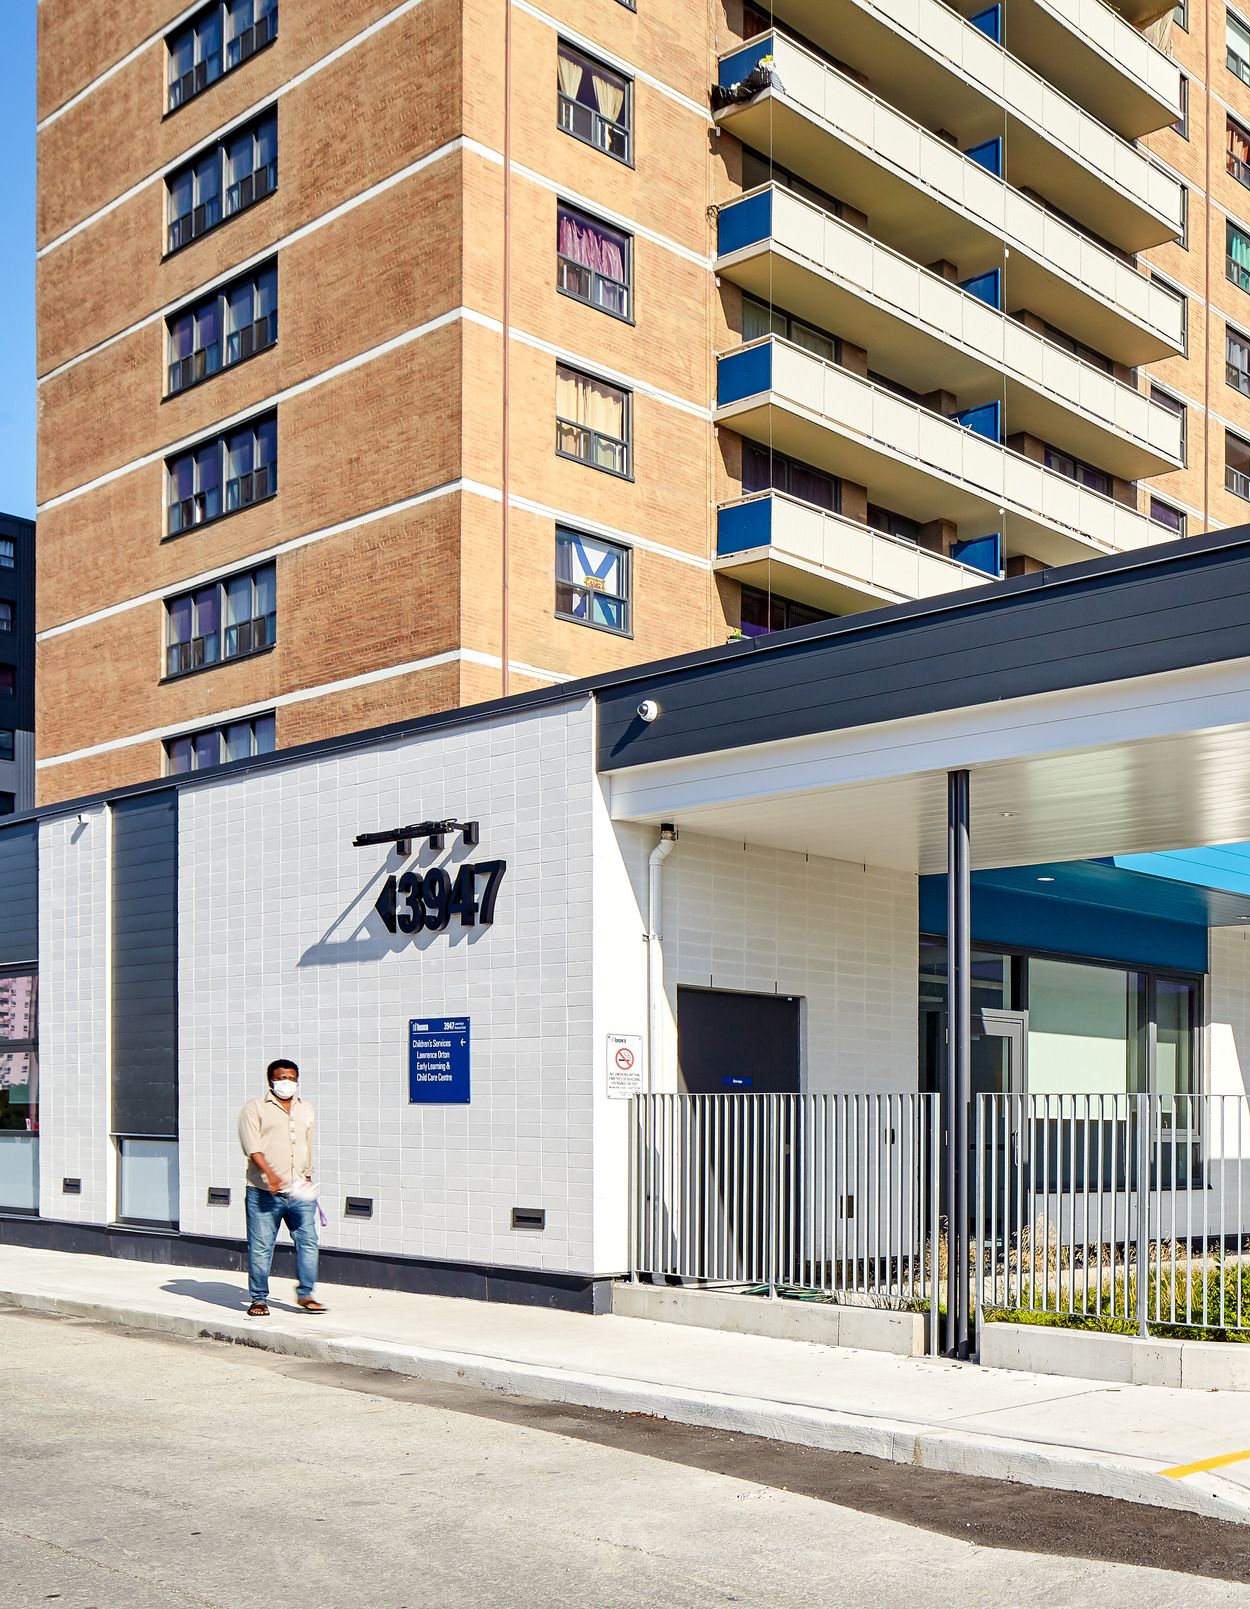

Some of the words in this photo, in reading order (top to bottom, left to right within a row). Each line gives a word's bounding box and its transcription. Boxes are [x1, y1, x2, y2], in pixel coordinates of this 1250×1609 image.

[397, 859, 506, 934] 3947
[444, 1022, 454, 1030] 3947
[412, 1040, 432, 1048] Children's
[433, 1039, 451, 1048] Services
[417, 1050, 437, 1059] Lawrence
[438, 1050, 450, 1059] Orton
[417, 1061, 427, 1071] Early
[428, 1062, 446, 1071] Learning
[446, 1062, 450, 1070] &
[417, 1073, 427, 1081] Child
[428, 1073, 438, 1081] Care
[438, 1073, 452, 1081] Centre
